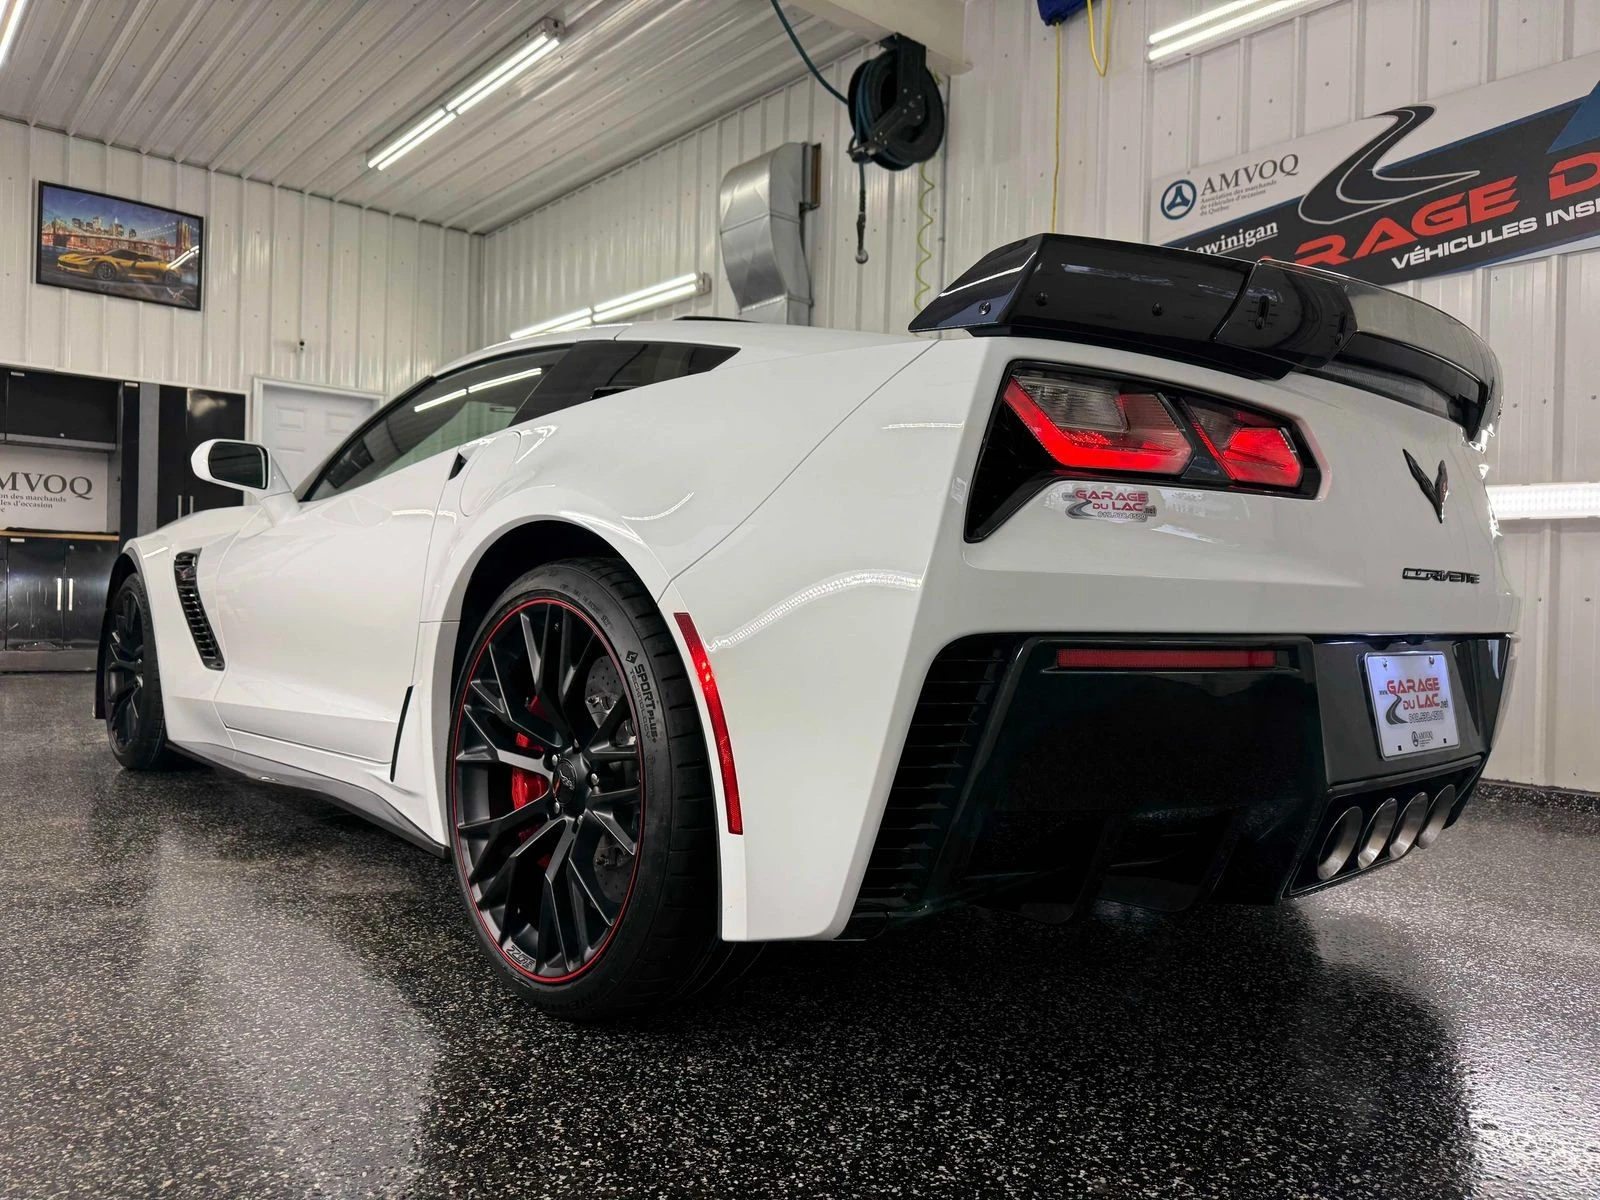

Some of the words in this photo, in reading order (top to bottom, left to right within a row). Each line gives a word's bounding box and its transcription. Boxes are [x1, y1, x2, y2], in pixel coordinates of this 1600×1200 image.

[1200, 153, 1299, 197] AMVOQ
[1261, 176, 1520, 266] RAGE
[1391, 217, 1538, 269] VÉHICULES
[1546, 197, 1600, 227] INS
[1183, 222, 1278, 254] awinigan
[1075, 489, 1148, 502] GARAGE
[1112, 501, 1143, 512] LAC
[1386, 677, 1440, 694] GARAGE
[1402, 699, 1416, 710] DU
[1416, 693, 1440, 708] LAC
